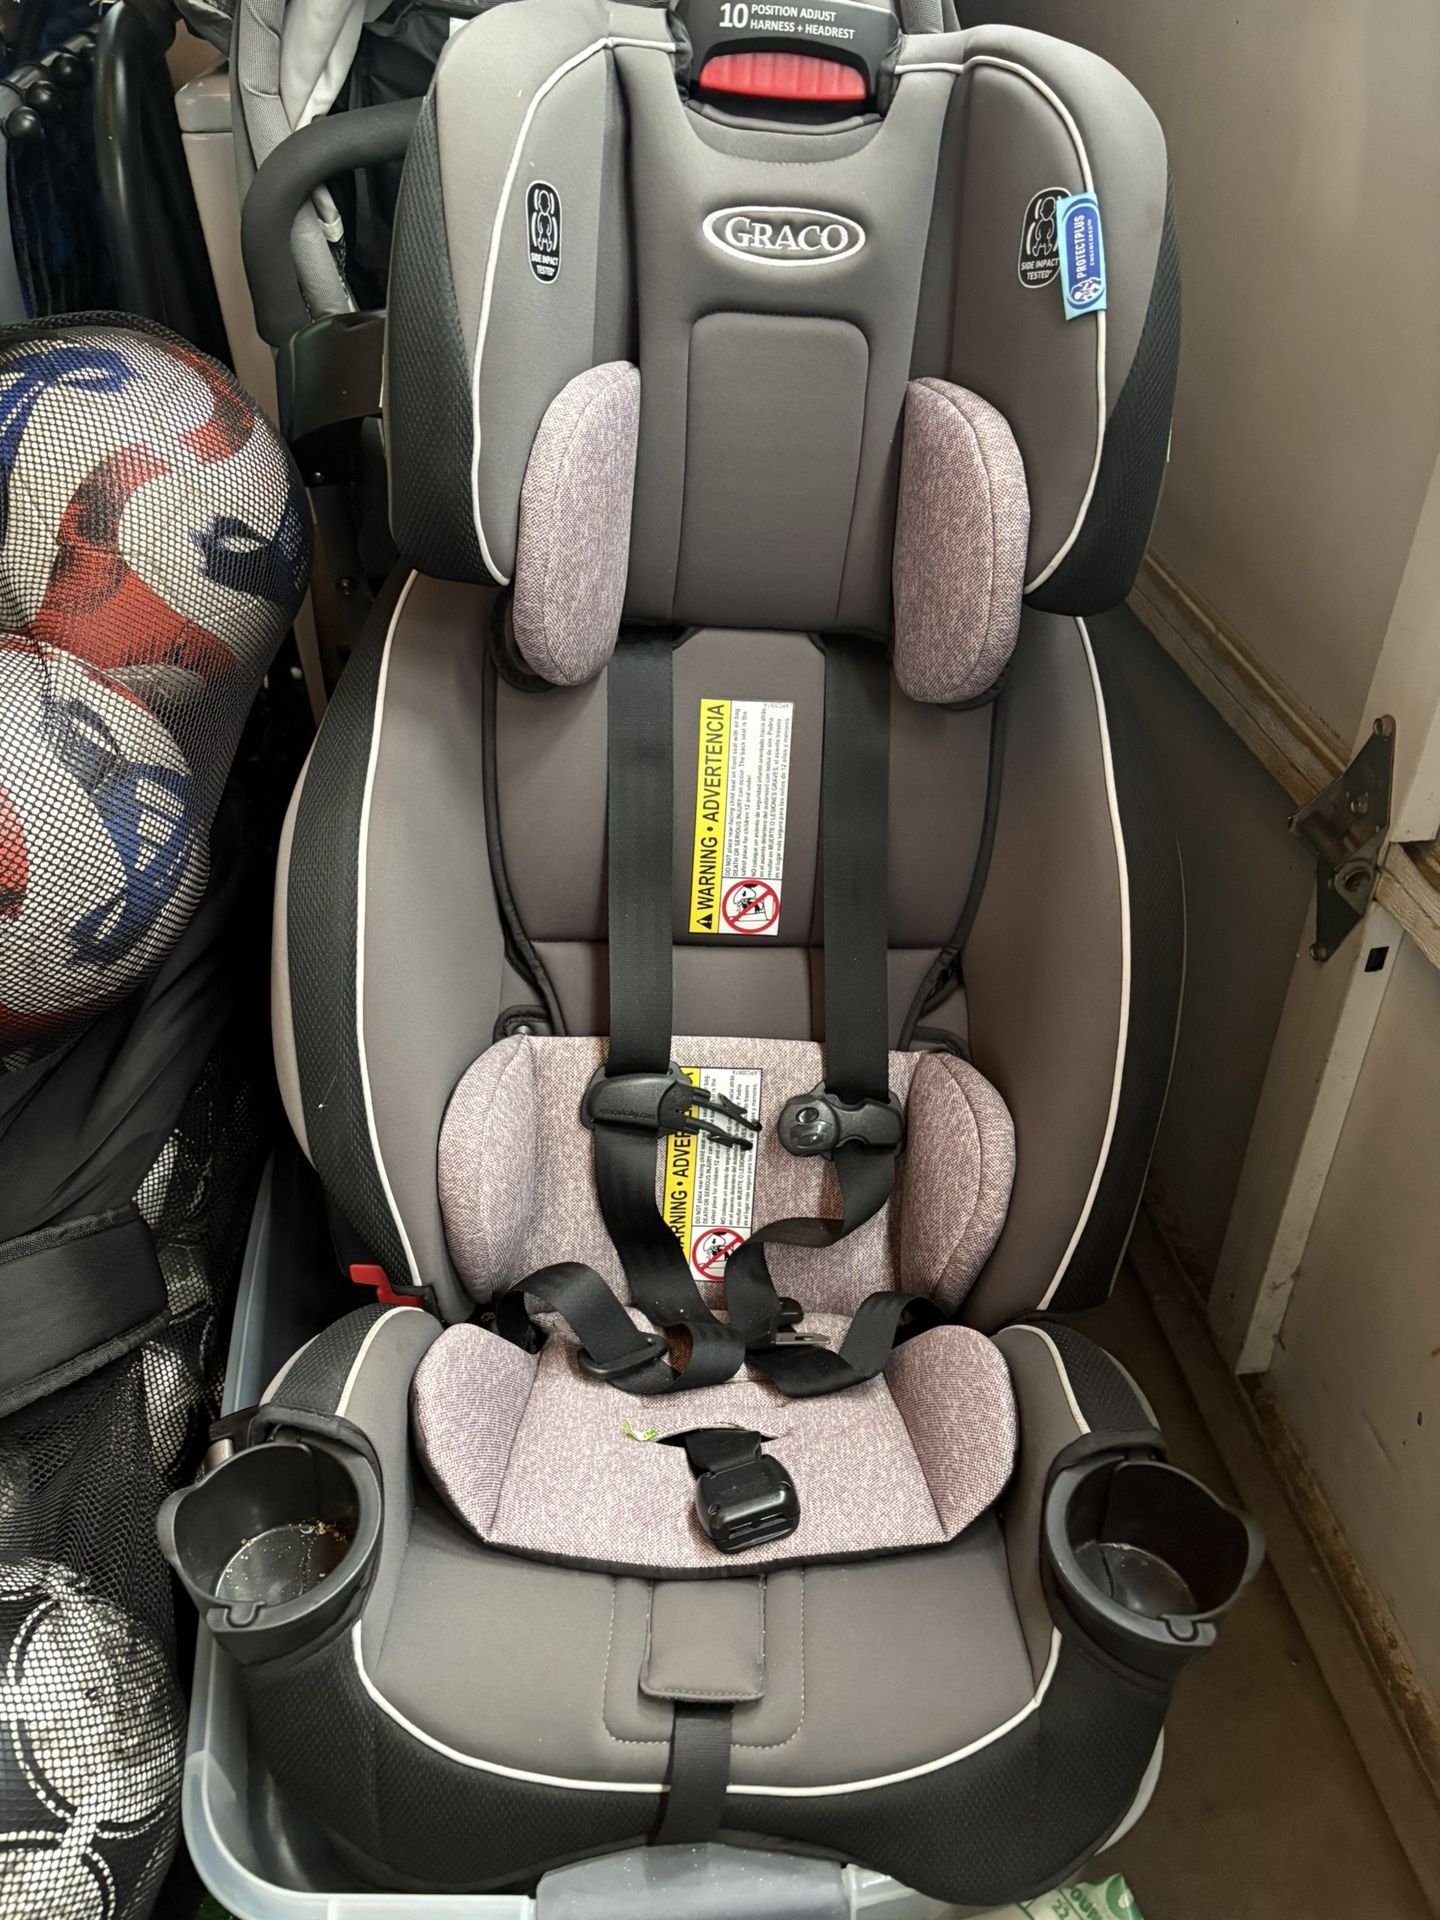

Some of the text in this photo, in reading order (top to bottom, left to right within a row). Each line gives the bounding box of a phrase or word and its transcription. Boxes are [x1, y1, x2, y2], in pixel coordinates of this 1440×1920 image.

[719, 3, 749, 29] 10
[751, 4, 837, 22] POSITION ADJUST
[750, 19, 795, 33] HARNESS
[805, 24, 855, 40] HEADREST
[725, 217, 848, 251] GRACO
[1074, 215, 1087, 278] PROTECTPLUS
[1020, 258, 1059, 271] SIDE IMPACT
[697, 704, 725, 910] WARNING ADVERTENCIA
[669, 1191, 687, 1250] ARNING
